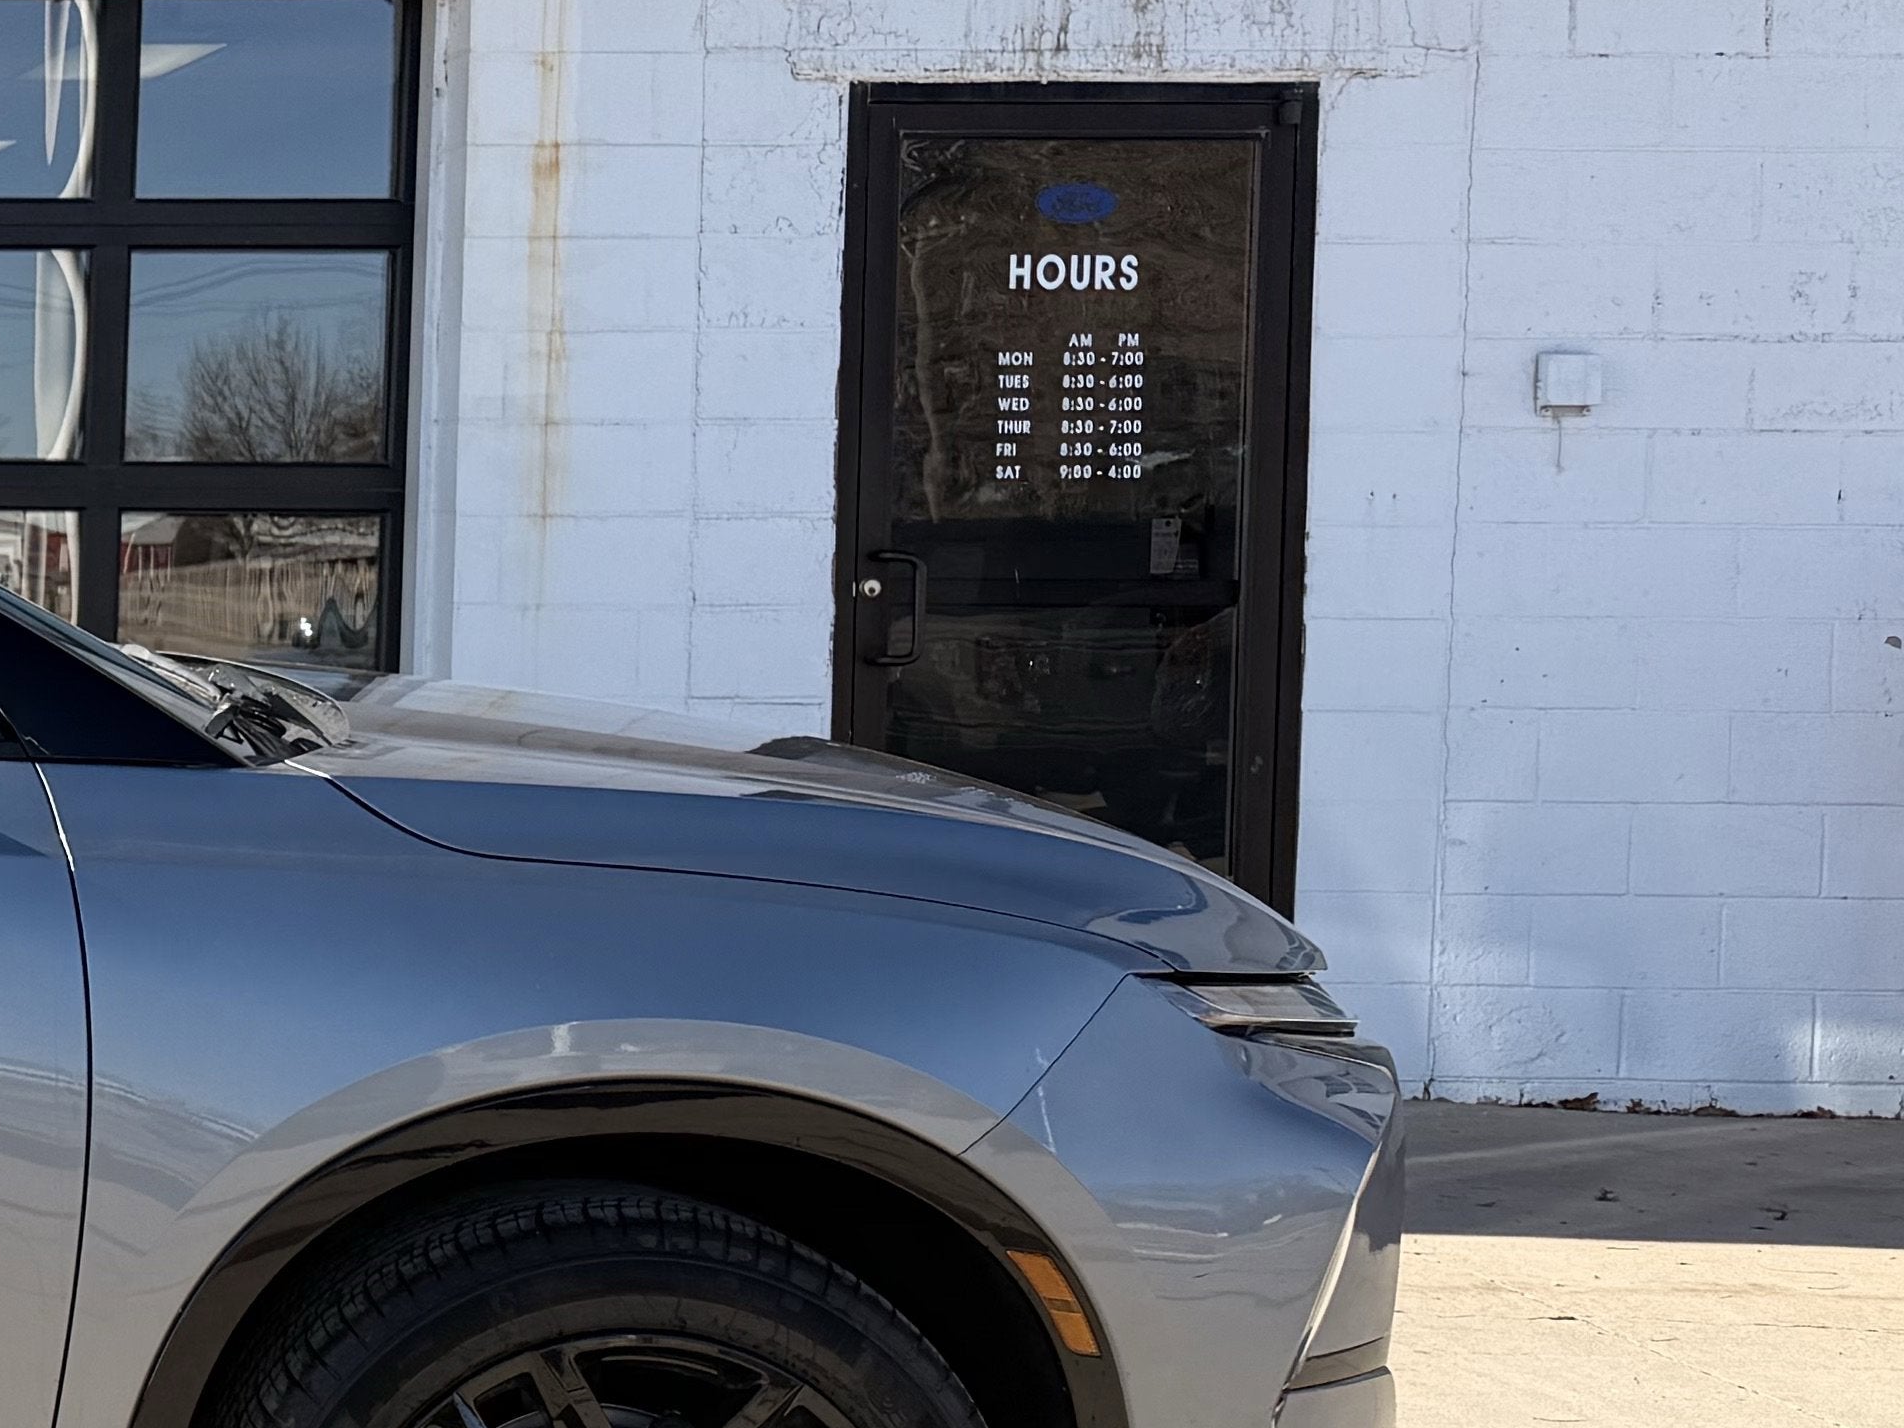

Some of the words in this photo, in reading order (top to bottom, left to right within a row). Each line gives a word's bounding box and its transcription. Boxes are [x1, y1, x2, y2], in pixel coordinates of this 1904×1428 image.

[1008, 253, 1139, 291] HOURS
[1068, 333, 1093, 348] AM
[1117, 332, 1140, 347] PM
[998, 351, 1034, 366] MON
[1062, 351, 1096, 366] 8:30
[1111, 351, 1144, 366] 7:00
[997, 374, 1030, 389] TUES
[1062, 373, 1095, 389] 8:30
[1108, 373, 1144, 389] 6:00
[997, 397, 1030, 412] WED
[1061, 396, 1094, 411] 8:30
[1107, 396, 1143, 412] 6:00
[997, 419, 1031, 435] THUR
[1060, 419, 1094, 435] 8:30
[1109, 419, 1142, 435] 7:00
[995, 442, 1017, 457] FRI
[1059, 442, 1093, 457] 8:30
[1108, 442, 1142, 457] 6:00
[995, 464, 1022, 480] SAT
[1059, 464, 1093, 480] 9:00
[1107, 464, 1142, 479] 4:00
